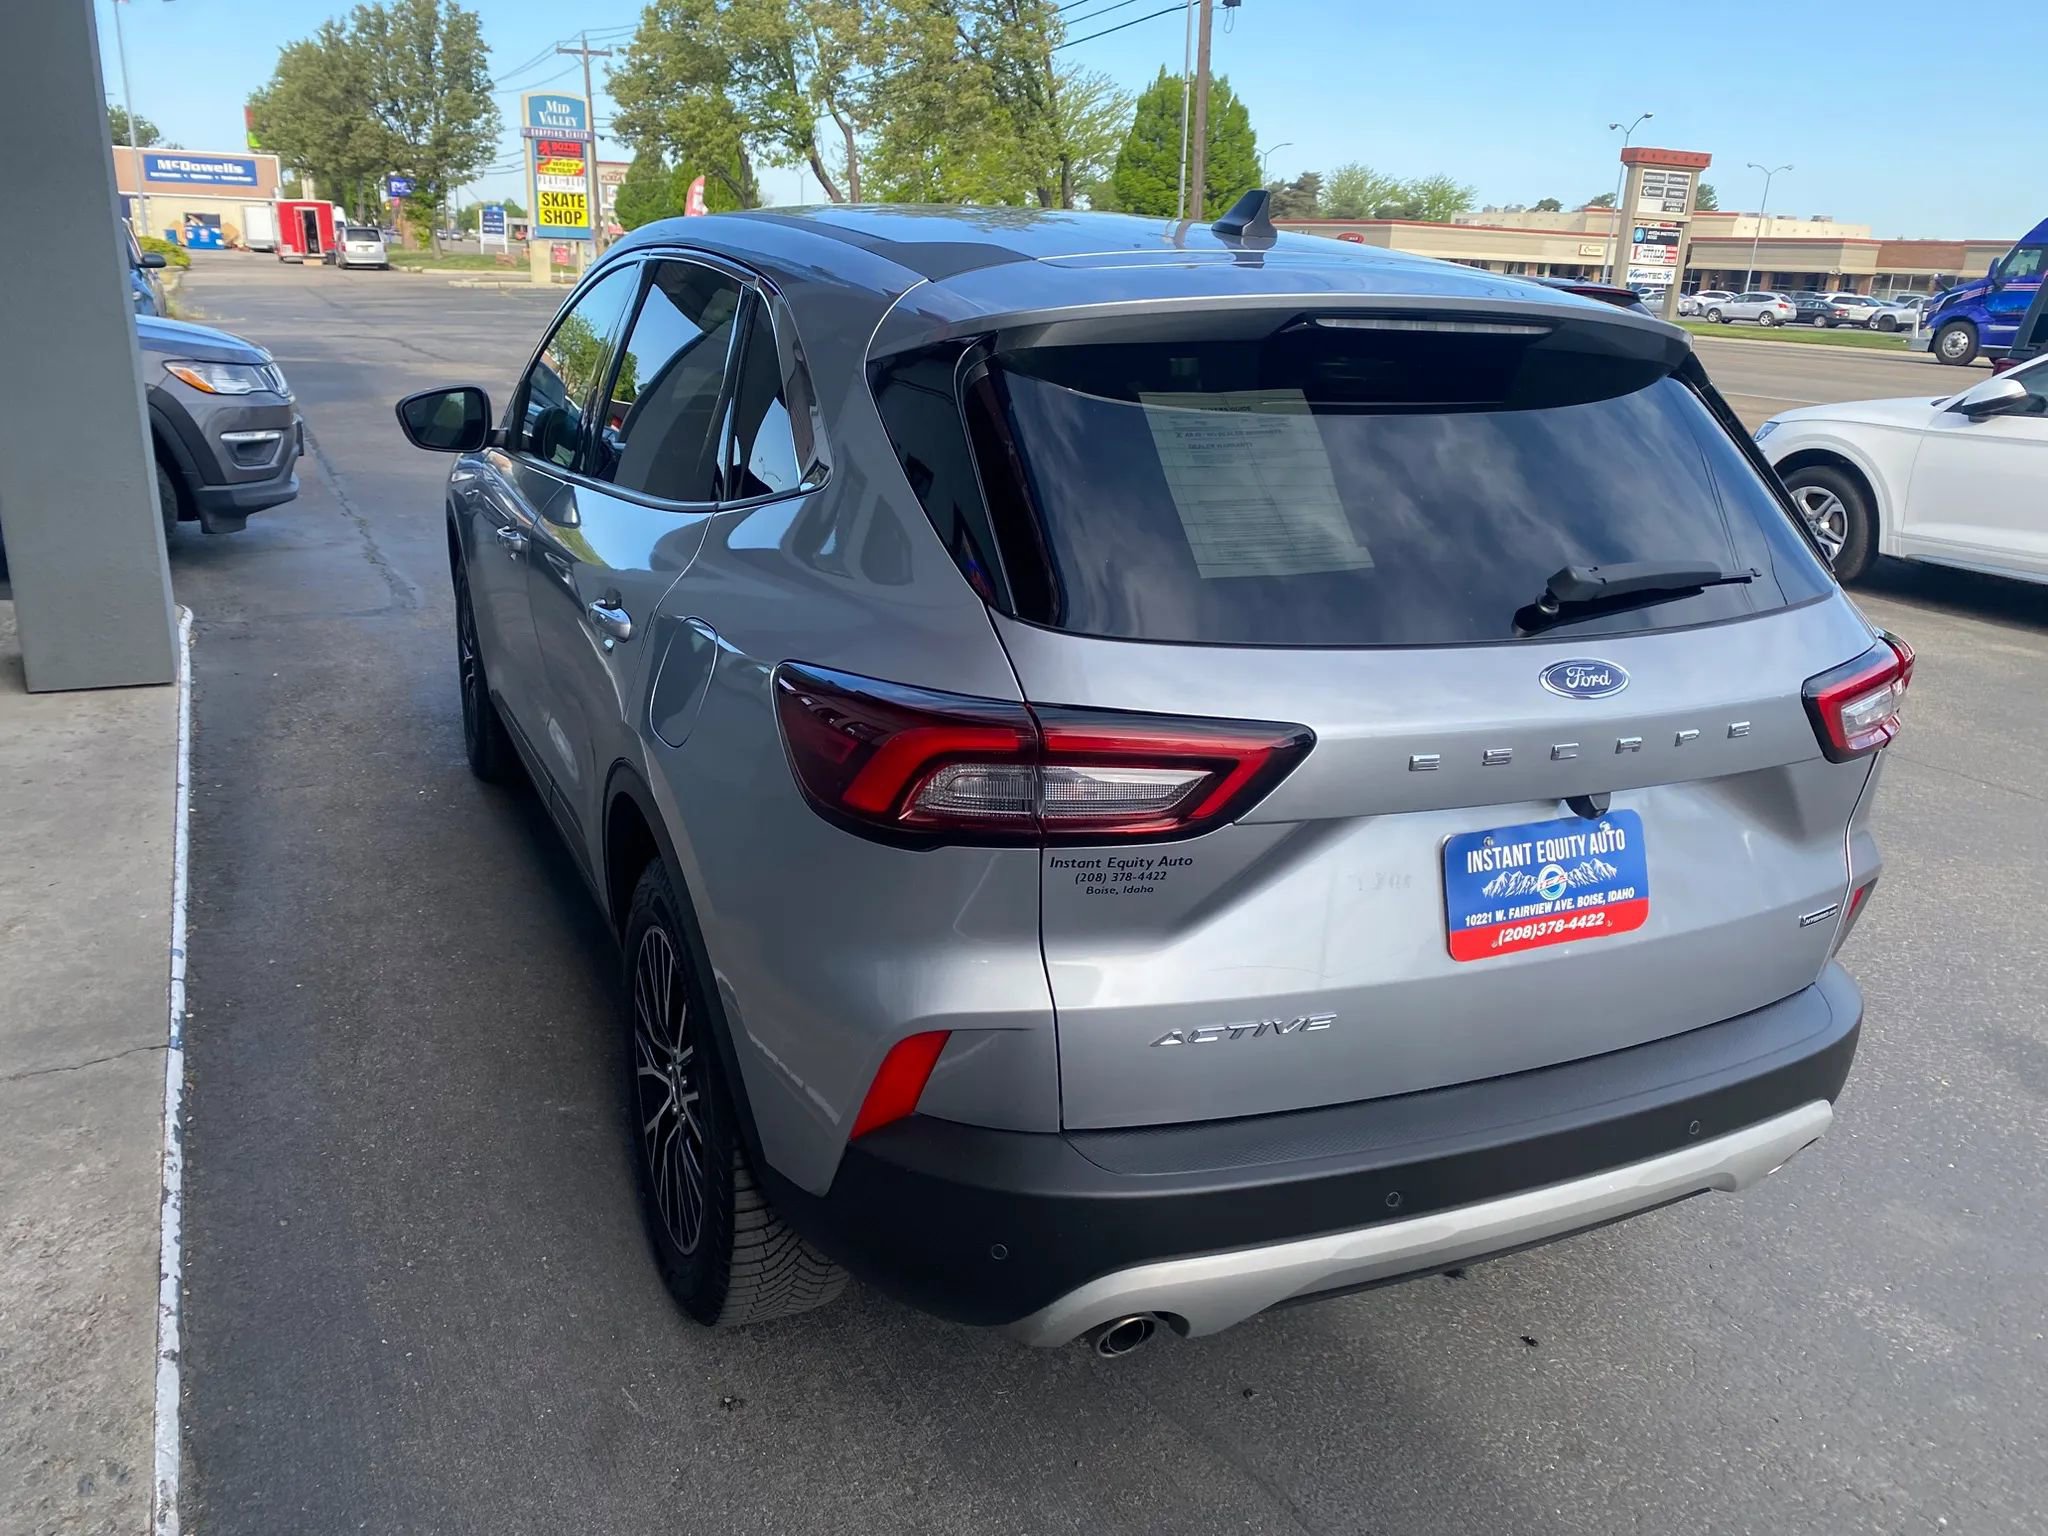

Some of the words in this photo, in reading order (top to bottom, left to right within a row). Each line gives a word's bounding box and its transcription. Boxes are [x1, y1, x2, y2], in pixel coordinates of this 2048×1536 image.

[538, 111, 578, 127] VALLEY
[157, 159, 245, 174] McDowells
[541, 192, 585, 208] SKATE
[543, 209, 582, 225] SHOP
[1566, 666, 1612, 689] Ford
[1409, 720, 1751, 772] ESCAPE
[1467, 843, 1532, 873] INSTANT
[1536, 835, 1587, 864] EQUITY
[1589, 828, 1626, 853] AUTO
[1049, 857, 1101, 869] Instant
[1107, 856, 1154, 871] Equity
[1158, 855, 1193, 867] Auto
[1075, 872, 1107, 885] (208)
[1111, 871, 1167, 883] 378-4422
[1086, 886, 1119, 896] Boise,
[1122, 885, 1154, 895] Idaho
[1465, 911, 1492, 927] 10221
[1495, 910, 1506, 922] W.
[1508, 902, 1552, 921] FAIRVIEW
[1554, 899, 1575, 915] AVE.
[1577, 893, 1606, 908] BOISE,
[1607, 887, 1635, 903] IDAHO
[1498, 912, 1606, 947] (208)378-4422
[1149, 1011, 1338, 1048] ACTIVE
